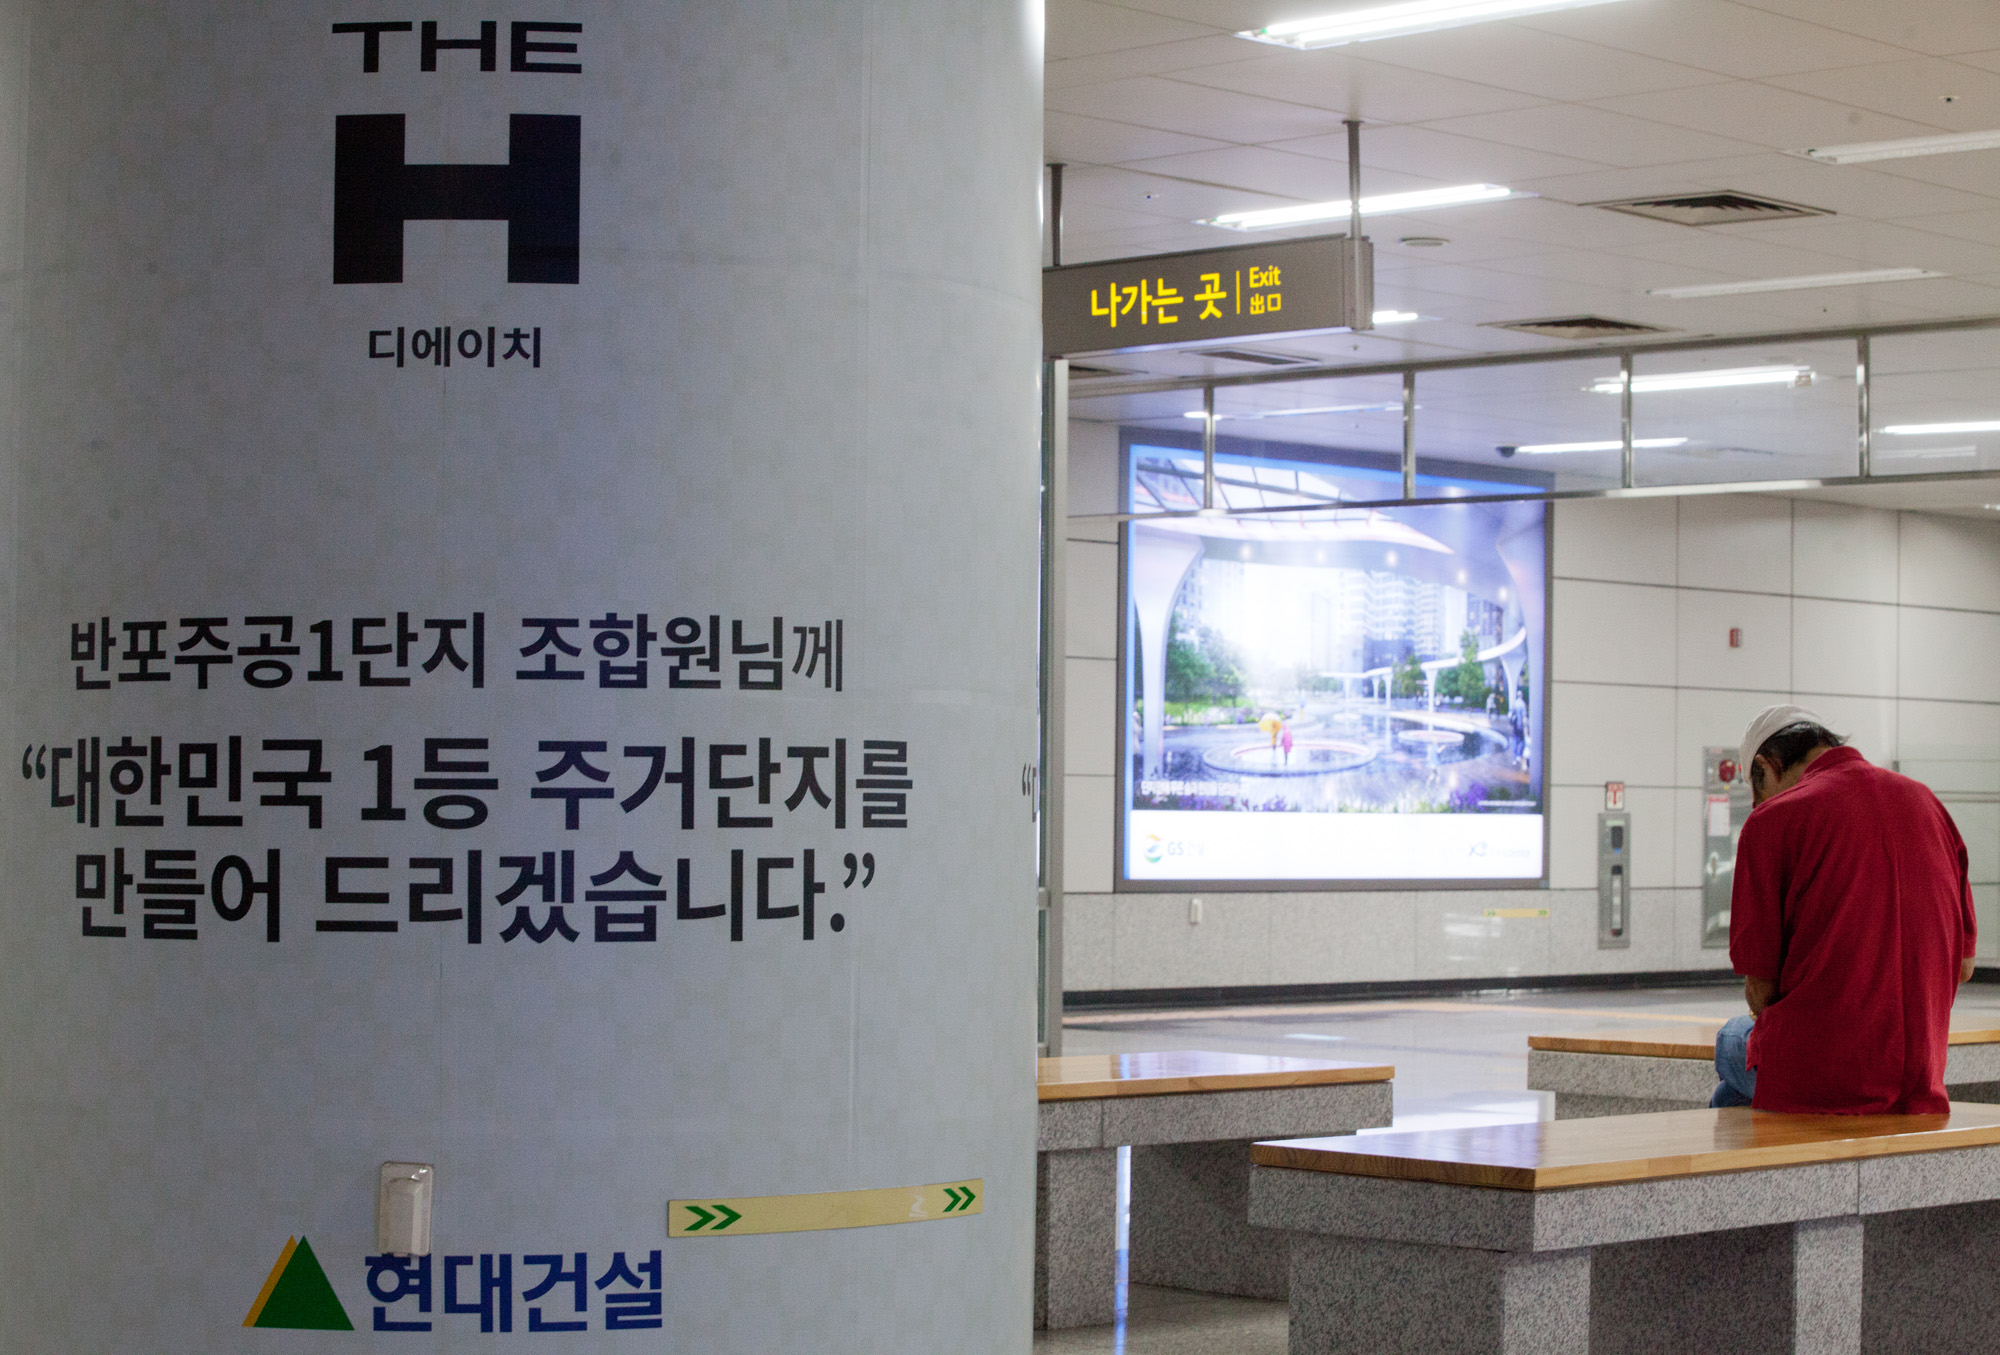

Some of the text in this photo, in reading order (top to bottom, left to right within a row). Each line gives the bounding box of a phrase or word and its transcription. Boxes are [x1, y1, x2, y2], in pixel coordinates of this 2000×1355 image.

[331, 20, 583, 74] THE
[333, 113, 581, 285] H
[1090, 272, 1228, 329] 나가는 곳
[1248, 264, 1282, 289] Exit
[1249, 292, 1283, 316] 出口
[368, 325, 542, 369] 디에이치
[70, 612, 843, 692] 반포주공1단지 조합원님께
[360, 738, 500, 831] 1등
[529, 736, 914, 832] 주거단지를
[75, 846, 281, 943] 만들어
[364, 1249, 663, 1334] 현대건설
